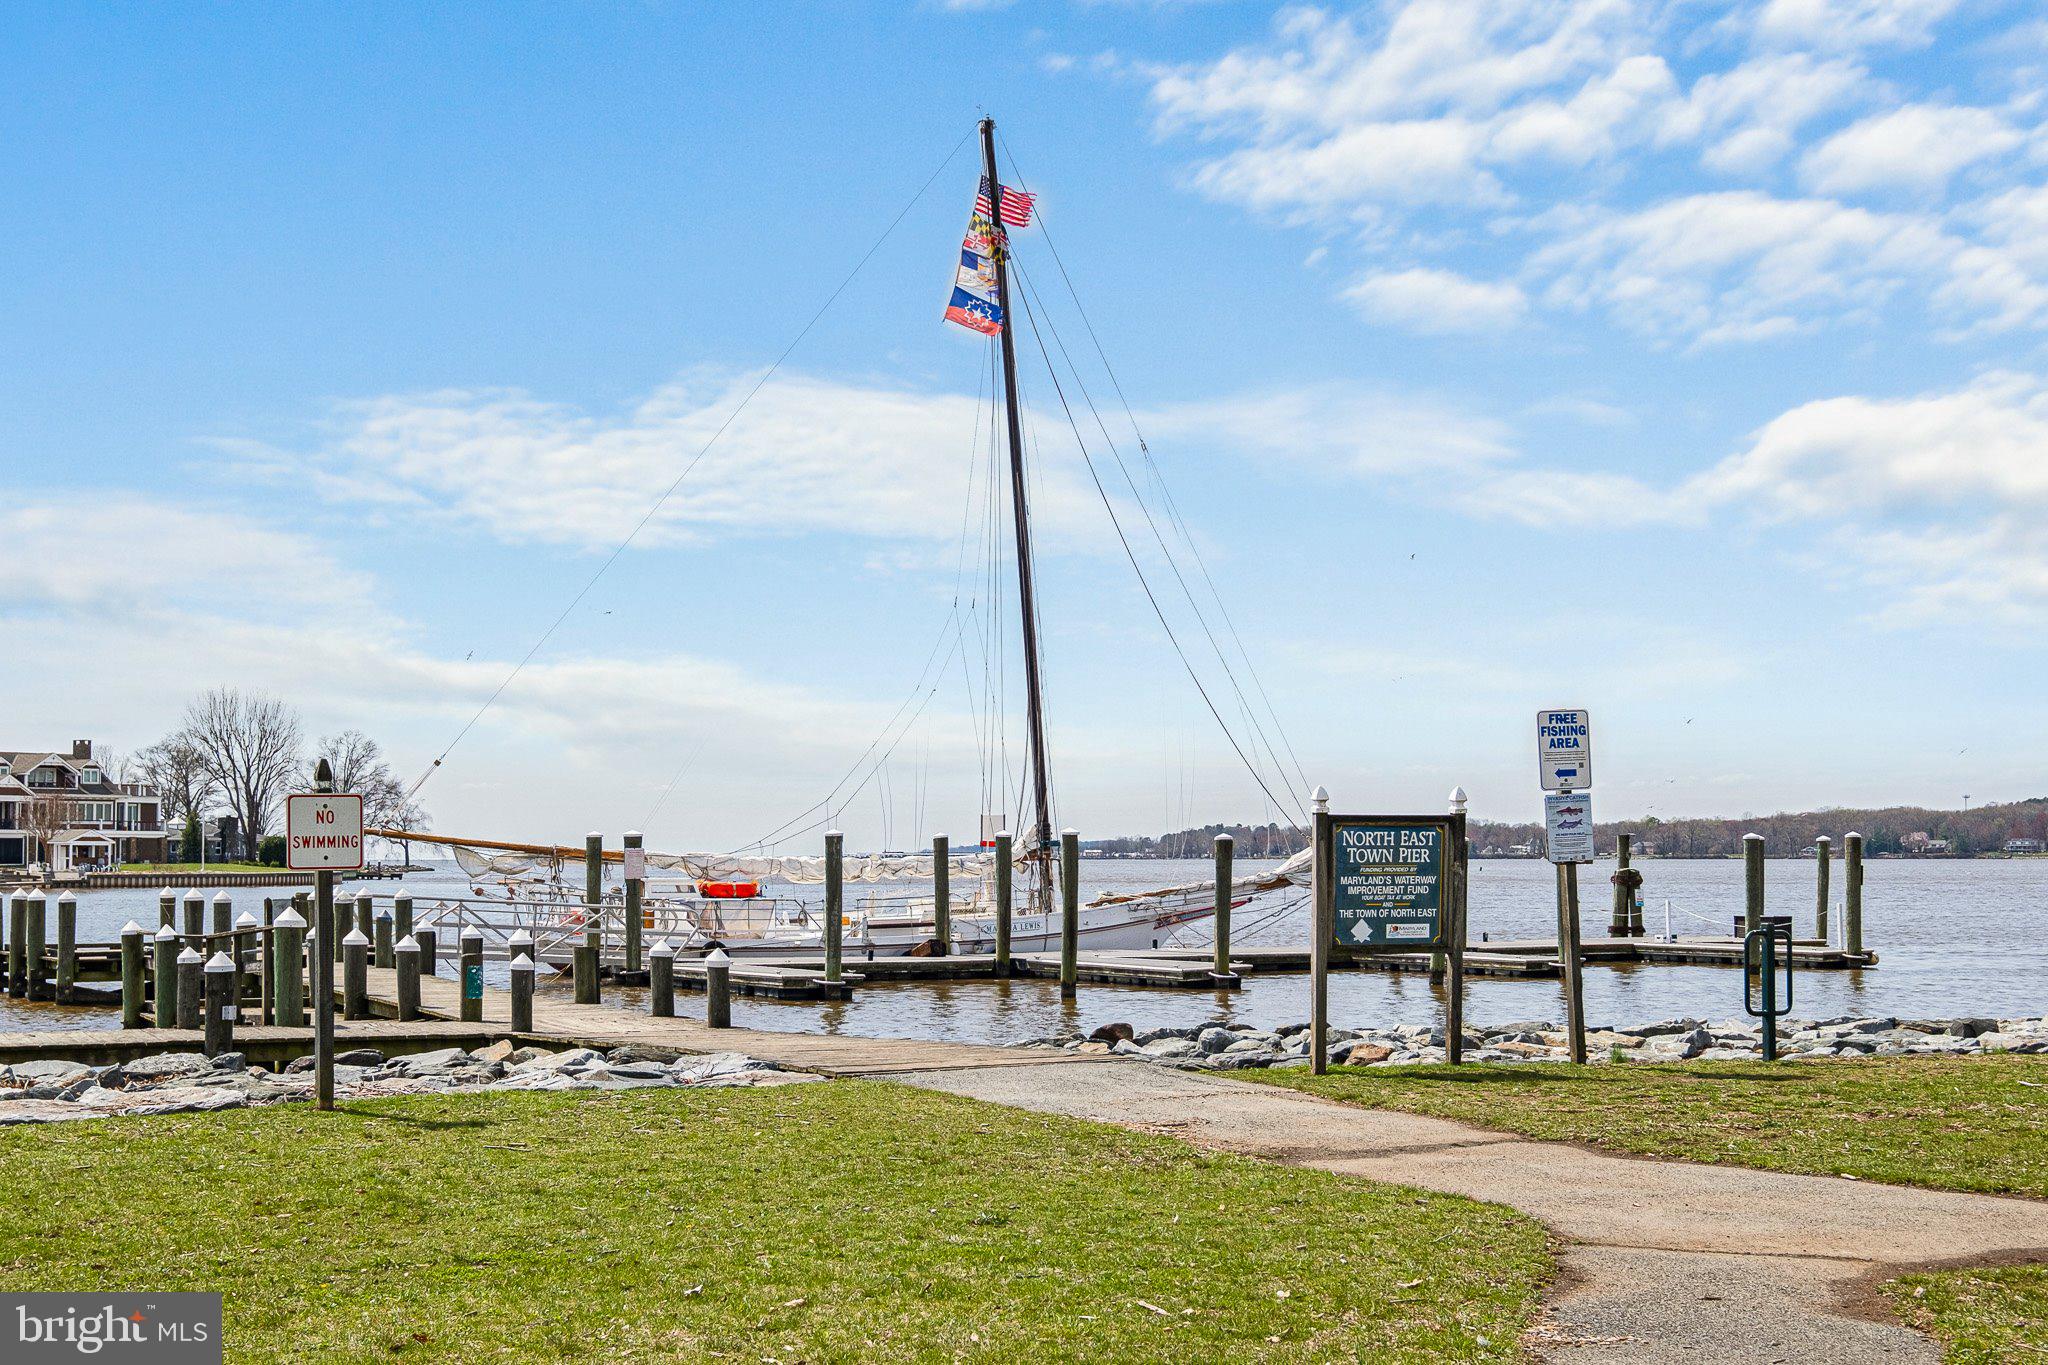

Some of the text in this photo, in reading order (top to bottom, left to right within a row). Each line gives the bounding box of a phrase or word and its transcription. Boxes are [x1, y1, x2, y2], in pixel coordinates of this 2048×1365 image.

[1548, 713, 1578, 725] FREE
[1541, 725, 1587, 737] FISHING
[1549, 738, 1580, 749] AREA
[316, 810, 335, 824] NO
[292, 835, 359, 849] SWIMMING
[1342, 830, 1436, 846] NORTH EAST
[1347, 848, 1431, 863] TOWN PIER
[1340, 875, 1437, 885] MARYLAND'S WATERWAY
[1348, 885, 1430, 895] IMPROVEMENT FUND
[1339, 908, 1437, 918] THE TOWN OF NORTH EAST
[1020, 922, 1041, 931] LEWIS
